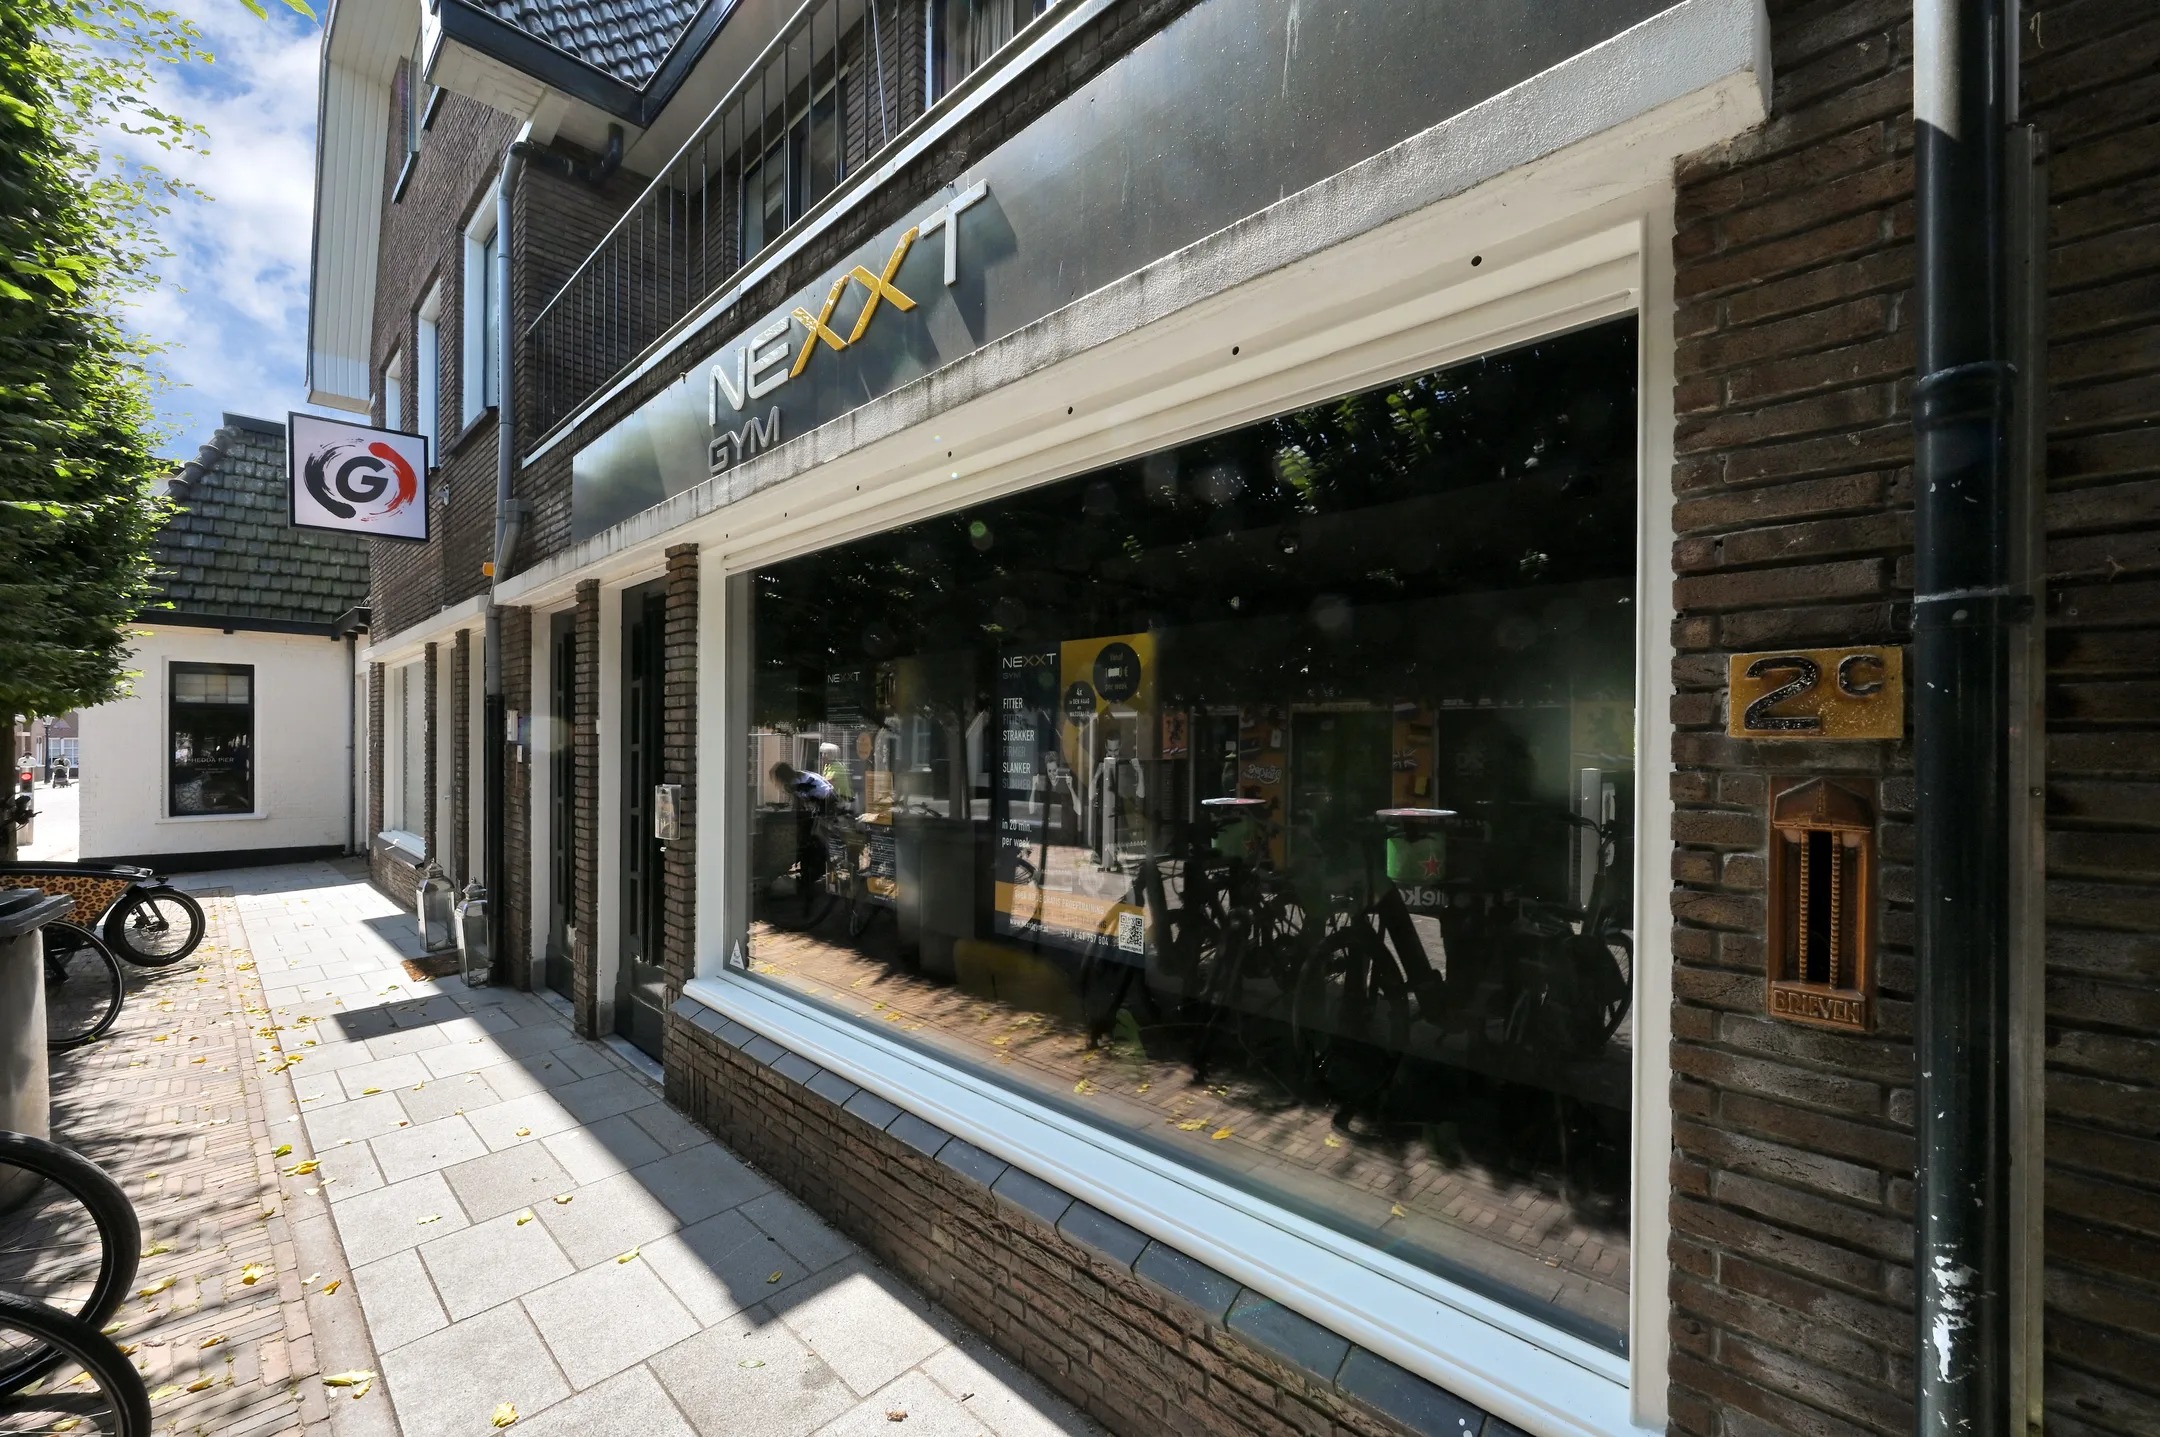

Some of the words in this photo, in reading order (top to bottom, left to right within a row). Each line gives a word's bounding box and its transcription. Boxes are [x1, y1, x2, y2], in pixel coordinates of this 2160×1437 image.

[709, 179, 987, 426] NEXXT
[709, 406, 780, 473] GYM
[336, 456, 388, 503] G
[1003, 653, 1056, 669] NEXXT
[827, 671, 861, 684] NEXXT
[1003, 672, 1020, 680] GYM
[1003, 698, 1023, 709] FITTER
[1003, 730, 1035, 741] STRAKKER
[1003, 762, 1031, 774] SLANKER
[1002, 818, 1008, 829] in
[1009, 819, 1017, 830] 20
[1002, 837, 1012, 847] per
[1773, 990, 1860, 1024] BRIEVEN
